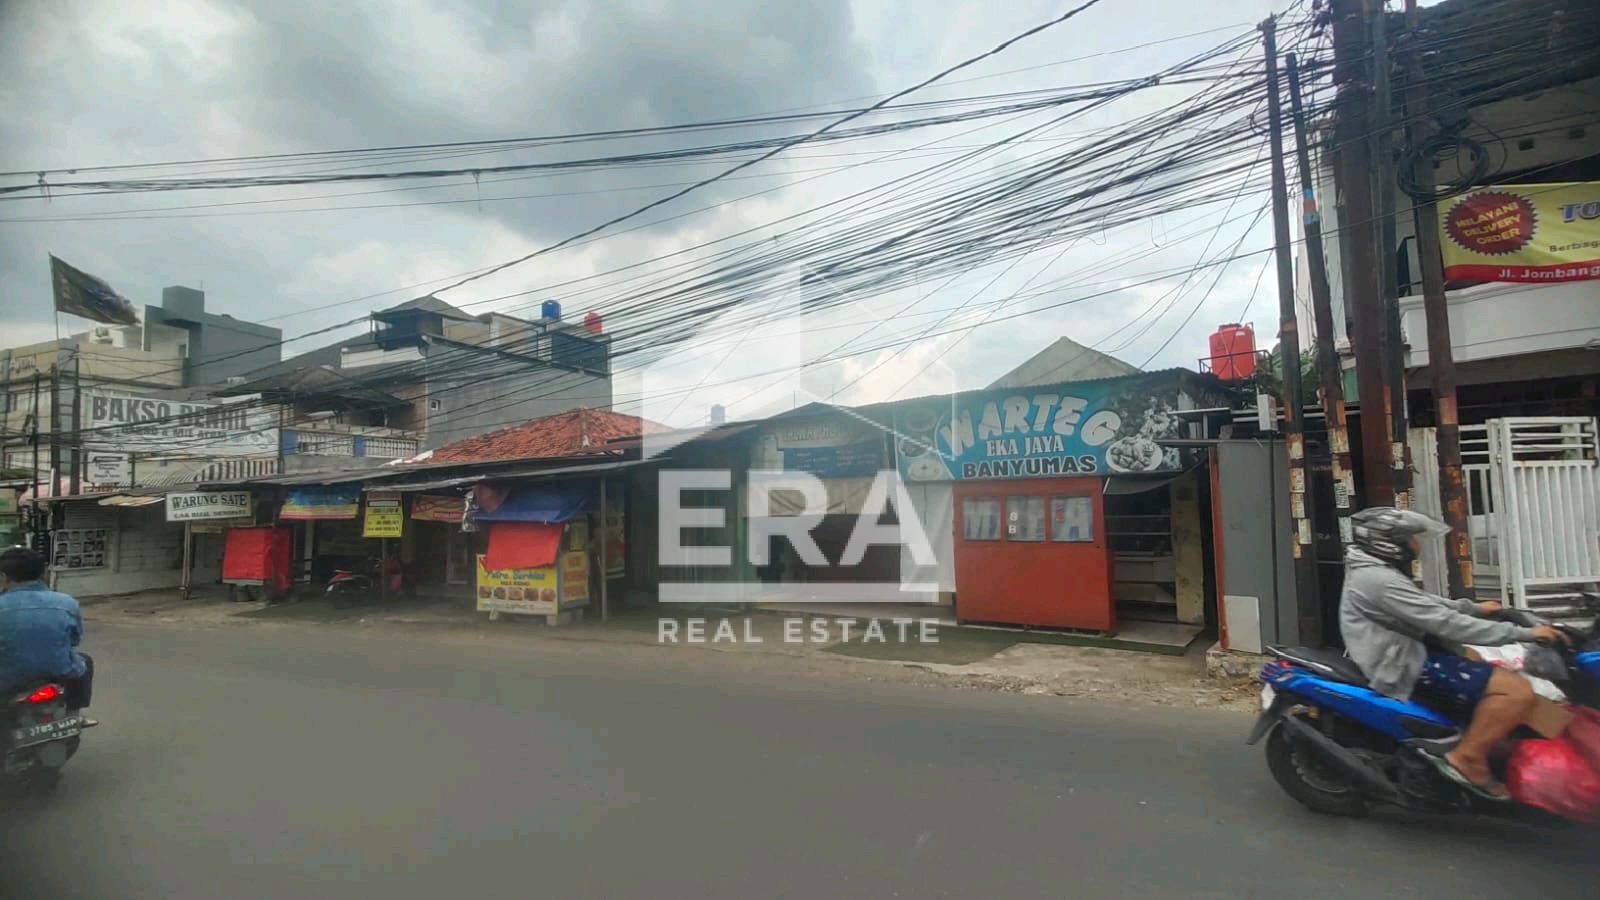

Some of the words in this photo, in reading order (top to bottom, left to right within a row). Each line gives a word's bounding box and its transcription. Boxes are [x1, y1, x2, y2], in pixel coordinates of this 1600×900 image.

[1456, 202, 1520, 228] MELAYANI
[1463, 214, 1521, 237] DELIVERY
[1477, 228, 1520, 245] ORDER
[1549, 241, 1600, 253] Berbag
[1498, 267, 1516, 279] Jl.
[1521, 265, 1600, 279] Jombang
[92, 397, 171, 424] BAKSO
[940, 394, 1121, 457] WARTEG
[986, 439, 1018, 457] EKA
[1024, 435, 1065, 456] JAYA
[963, 454, 1096, 479] BANYUMAS
[172, 495, 218, 510] WARUNG
[221, 494, 248, 506] SATE
